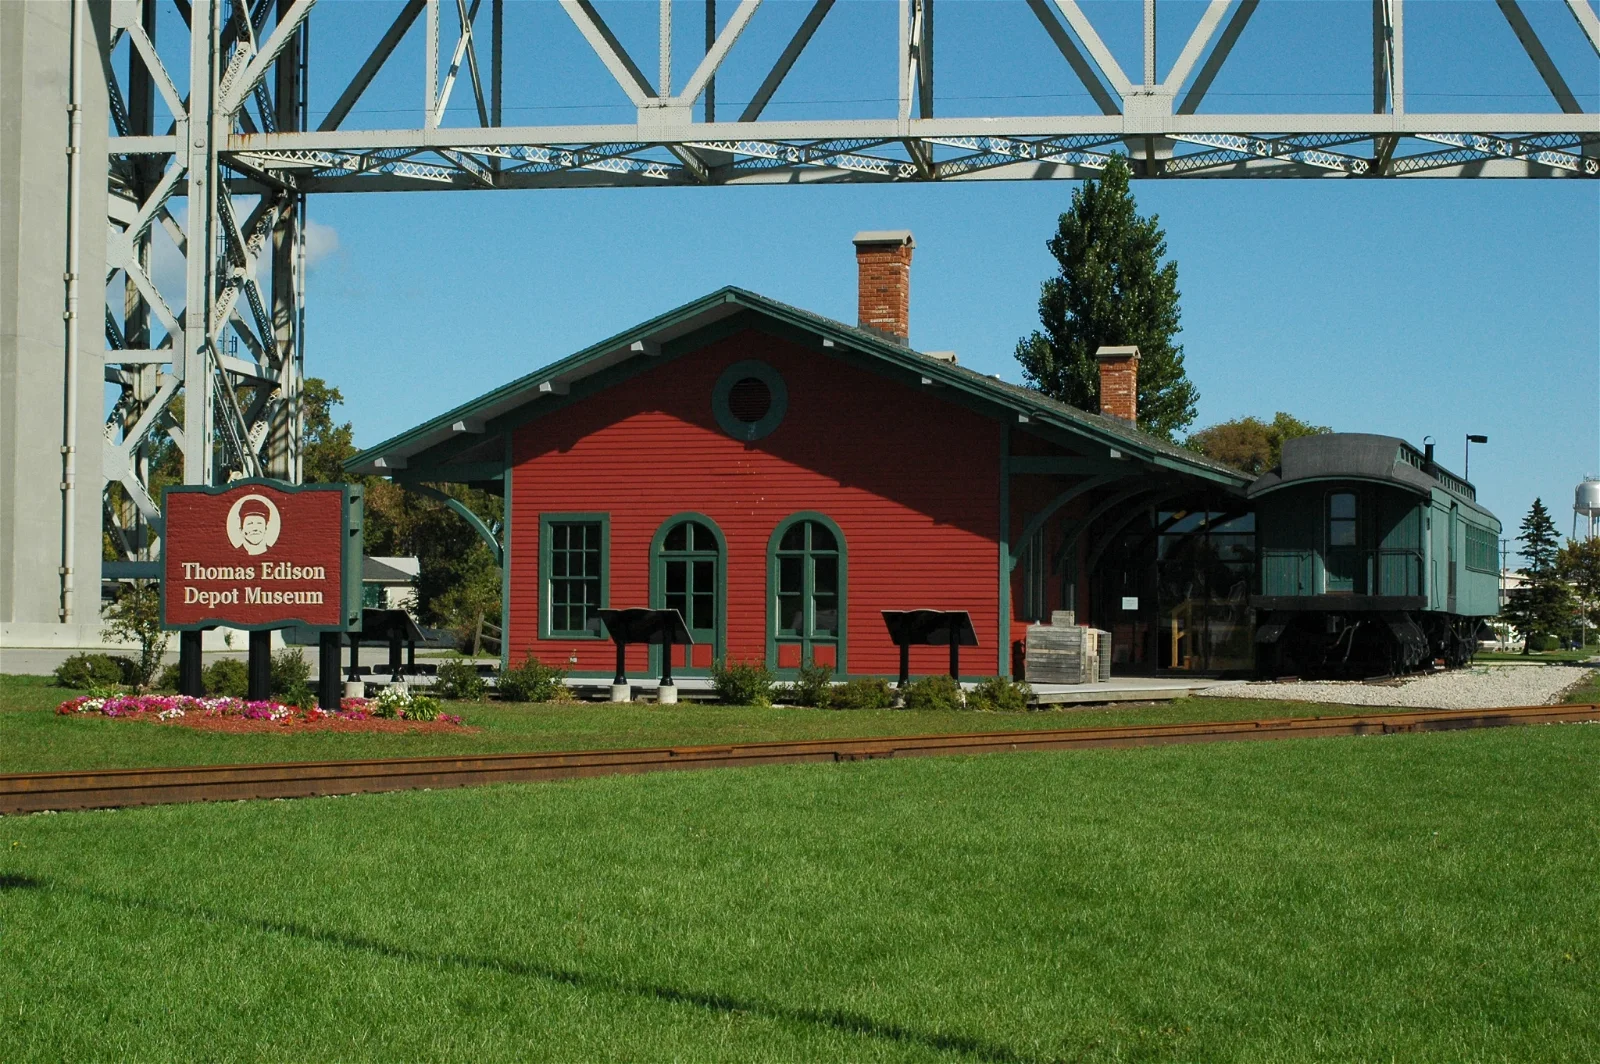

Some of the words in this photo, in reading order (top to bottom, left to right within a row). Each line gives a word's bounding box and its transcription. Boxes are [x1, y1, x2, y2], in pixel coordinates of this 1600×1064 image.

[181, 562, 255, 580] Thomas
[261, 561, 326, 580] Edison
[184, 586, 239, 609] Depot
[244, 586, 324, 605] Museum
